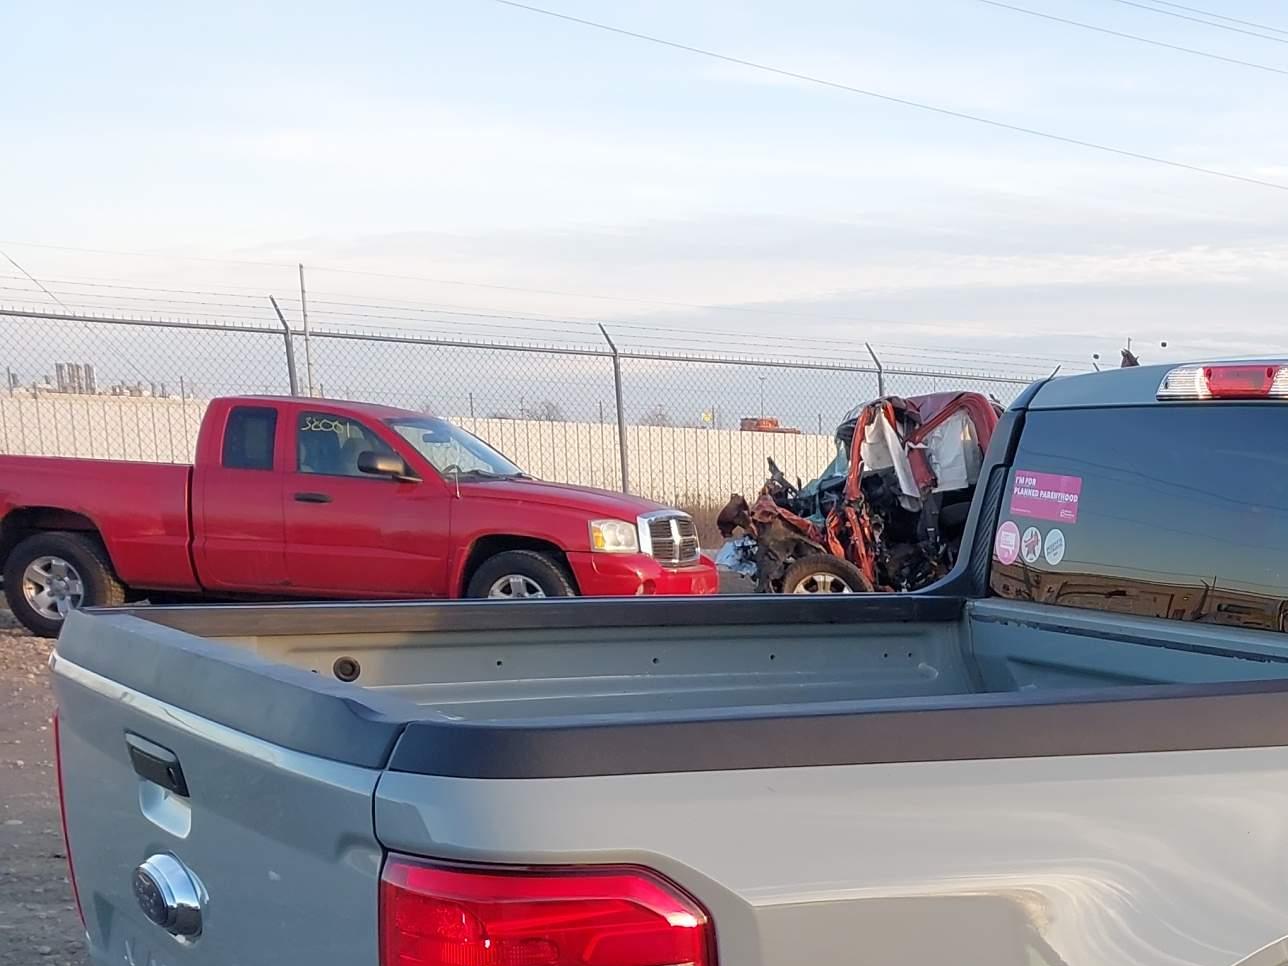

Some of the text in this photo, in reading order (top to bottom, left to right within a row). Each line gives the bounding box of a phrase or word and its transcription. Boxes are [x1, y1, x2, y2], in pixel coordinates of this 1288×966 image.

[1025, 477, 1037, 487] FOR
[1013, 486, 1079, 503] PLANNED PARENTHOOD
